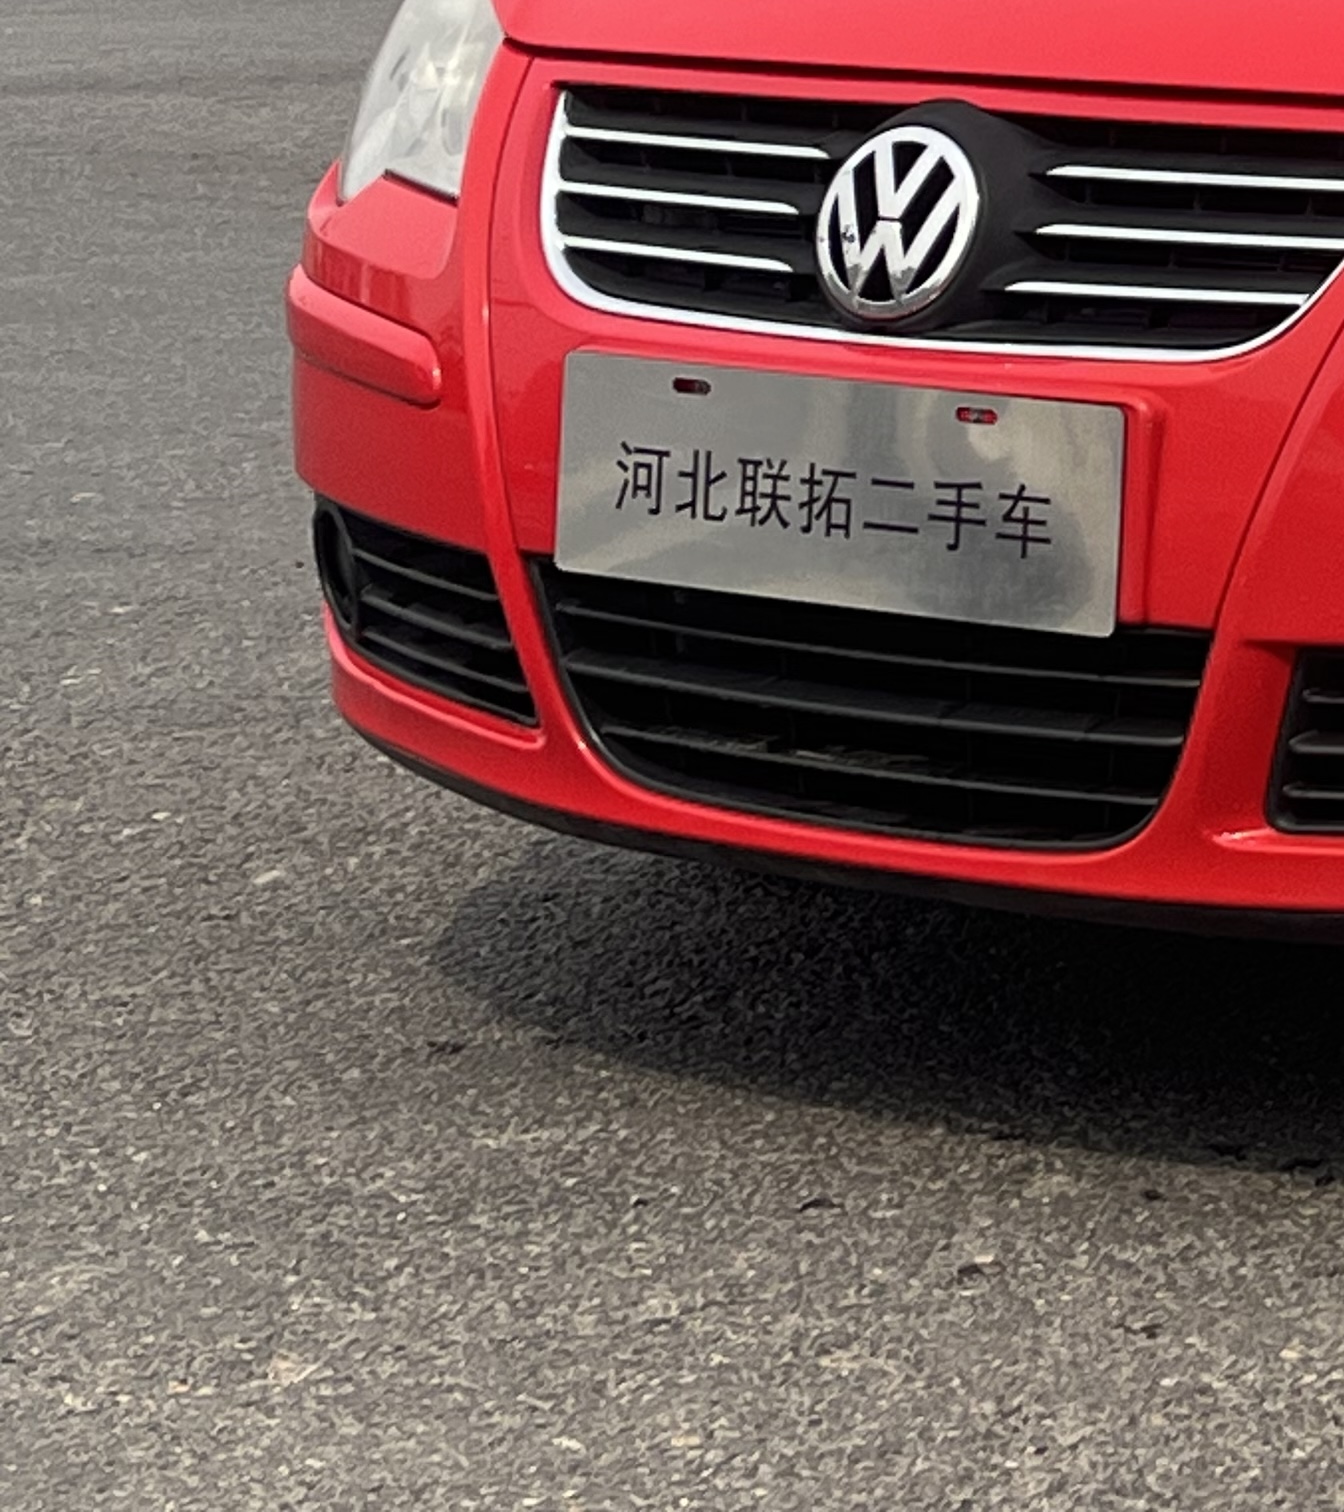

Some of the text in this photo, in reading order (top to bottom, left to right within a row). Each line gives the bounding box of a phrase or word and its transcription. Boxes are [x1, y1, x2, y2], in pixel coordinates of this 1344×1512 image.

[613, 440, 1053, 559] 河北联拓二手车
